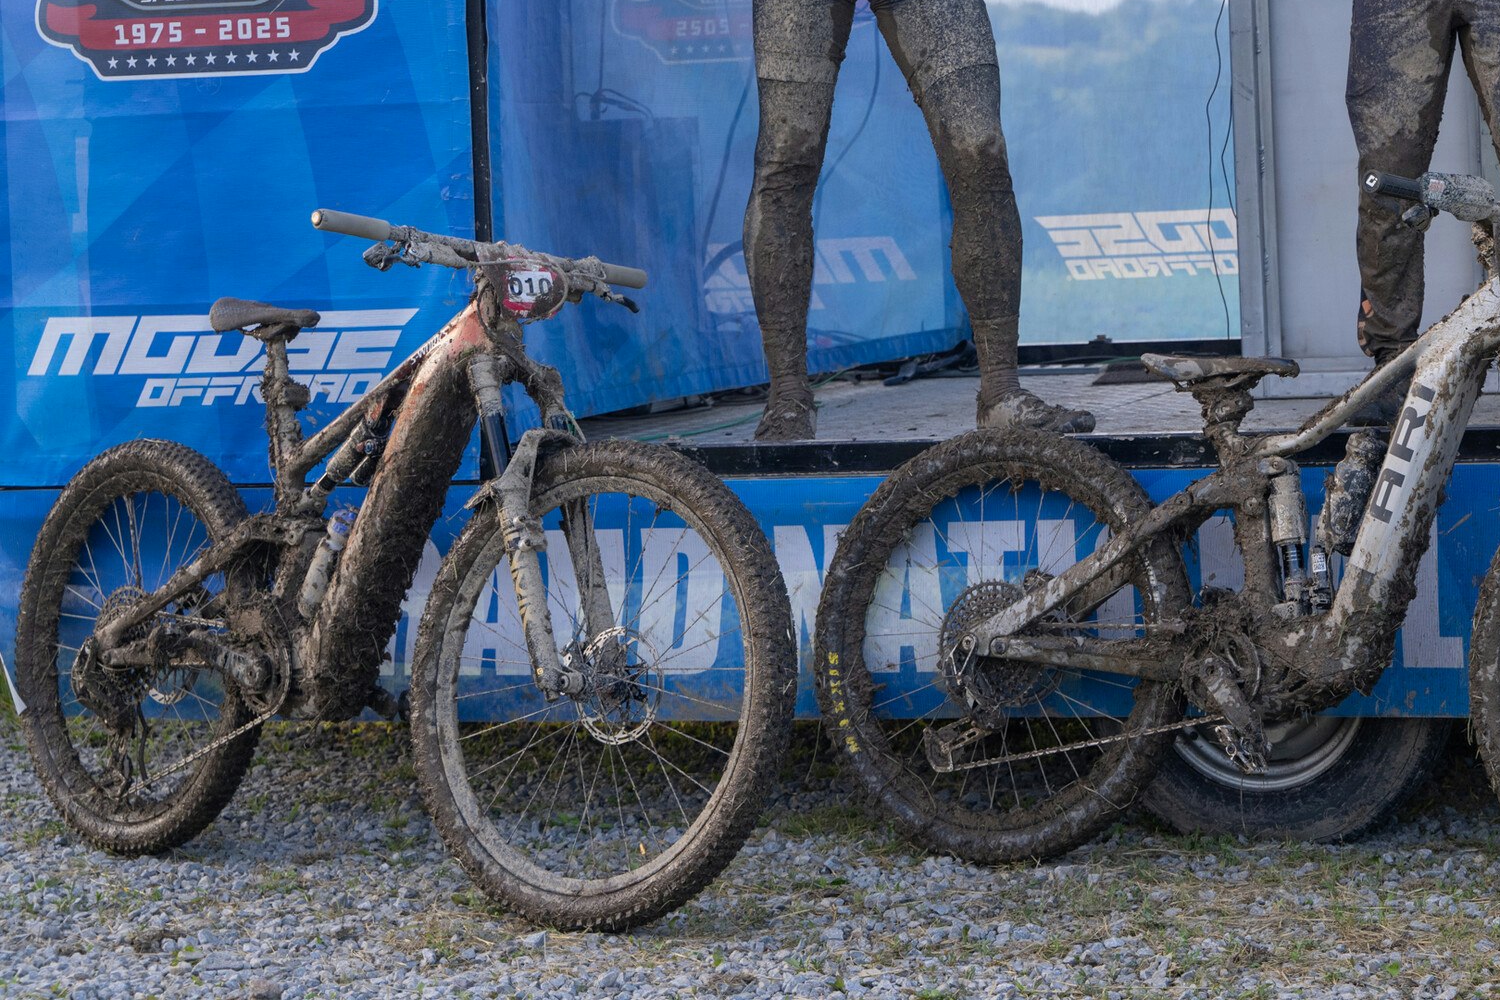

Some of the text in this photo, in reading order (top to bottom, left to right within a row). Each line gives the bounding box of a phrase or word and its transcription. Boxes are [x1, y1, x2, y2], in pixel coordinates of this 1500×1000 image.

[115, 22, 182, 45] 1975
[219, 17, 291, 39] 2025
[136, 372, 383, 408] OFFRAD
[1370, 381, 1436, 524] ARI
